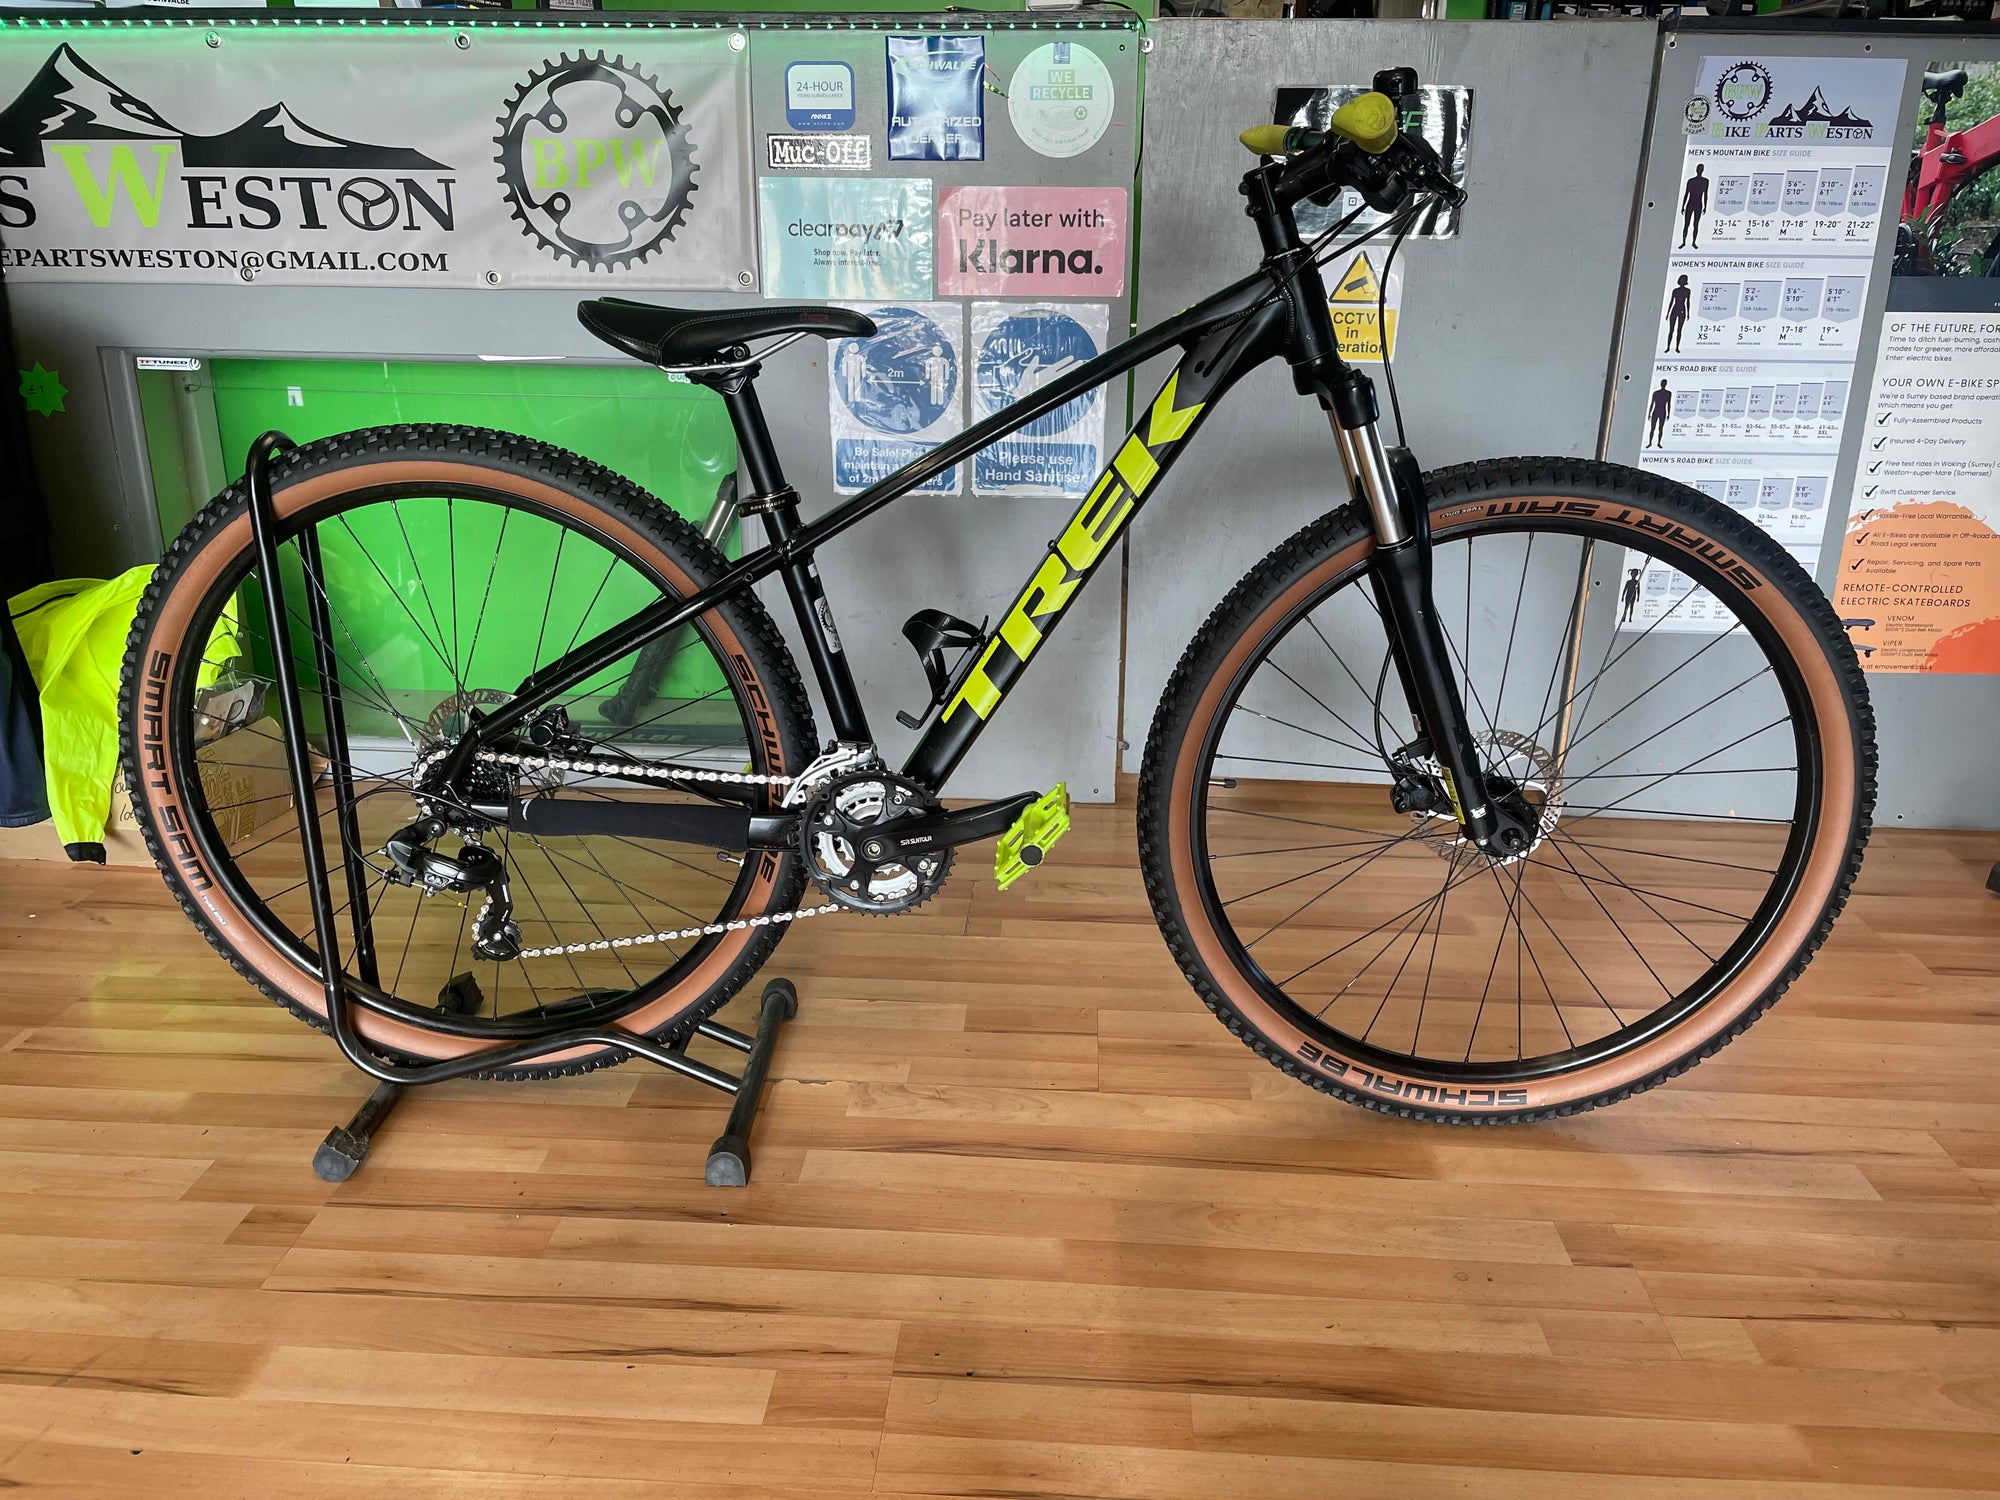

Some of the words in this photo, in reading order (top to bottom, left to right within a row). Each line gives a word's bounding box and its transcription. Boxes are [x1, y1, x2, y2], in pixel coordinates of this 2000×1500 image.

[1050, 71, 1072, 83] WE
[797, 82, 843, 92] 24-HOUR
[1032, 87, 1090, 99] RECYCLE
[1724, 84, 1765, 100] BPW
[892, 117, 982, 127] AUTRIZED
[1711, 123, 1751, 138] BIKE
[1754, 123, 1804, 138] PARTS
[1807, 123, 1874, 140] WESTON
[773, 140, 865, 164] Muc-Off
[1713, 149, 1752, 157] MOUNTAIN
[527, 138, 664, 191] BPW
[51, 145, 456, 232] WESTON
[959, 208, 998, 232] Pay
[1004, 208, 1052, 228] later
[1060, 208, 1105, 228] with
[788, 218, 874, 244] clearpay
[814, 248, 830, 257] Shop
[850, 249, 862, 258] Pay
[958, 238, 1104, 274] Klarna.
[1333, 312, 1376, 325] CCTV
[1346, 326, 1359, 338] in
[1890, 323, 1906, 332] OF
[1910, 323, 1930, 332] THE
[1934, 324, 1976, 334] FUTURE,
[1337, 340, 1384, 354] eratio
[887, 368, 905, 378] 2m
[1882, 378, 1913, 387] YOUR
[1916, 378, 1945, 387] OWN
[1948, 378, 1984, 388] E-BIKE
[1906, 393, 1928, 401] Surrey
[854, 446, 869, 457] Be
[871, 447, 899, 458] Safe!
[901, 448, 926, 458] Plea
[998, 452, 1044, 465] Please
[1048, 456, 1074, 465] use
[844, 460, 890, 471] maintain
[1968, 461, 1996, 469] (Surrey)
[848, 474, 861, 483] of
[984, 468, 1021, 481] Hand
[1025, 470, 1087, 482] Sanitiser
[1954, 470, 1992, 478] (Somerset)
[750, 499, 786, 510] BONTRAGER
[1485, 500, 1600, 518] SAM
[941, 368, 1206, 724] TREK
[1603, 508, 1764, 592] SMART
[1943, 560, 1963, 568] Spare
[1843, 584, 1964, 594] REMOTE-CONTROLLED
[1840, 597, 1890, 606] ELECTRIC
[1893, 598, 1971, 608] SKATEBOARDS
[140, 650, 172, 796] SMART
[158, 804, 214, 893] SAM
[731, 653, 788, 886] SCHWAE
[1296, 1040, 1528, 1106] SCHWALBE
